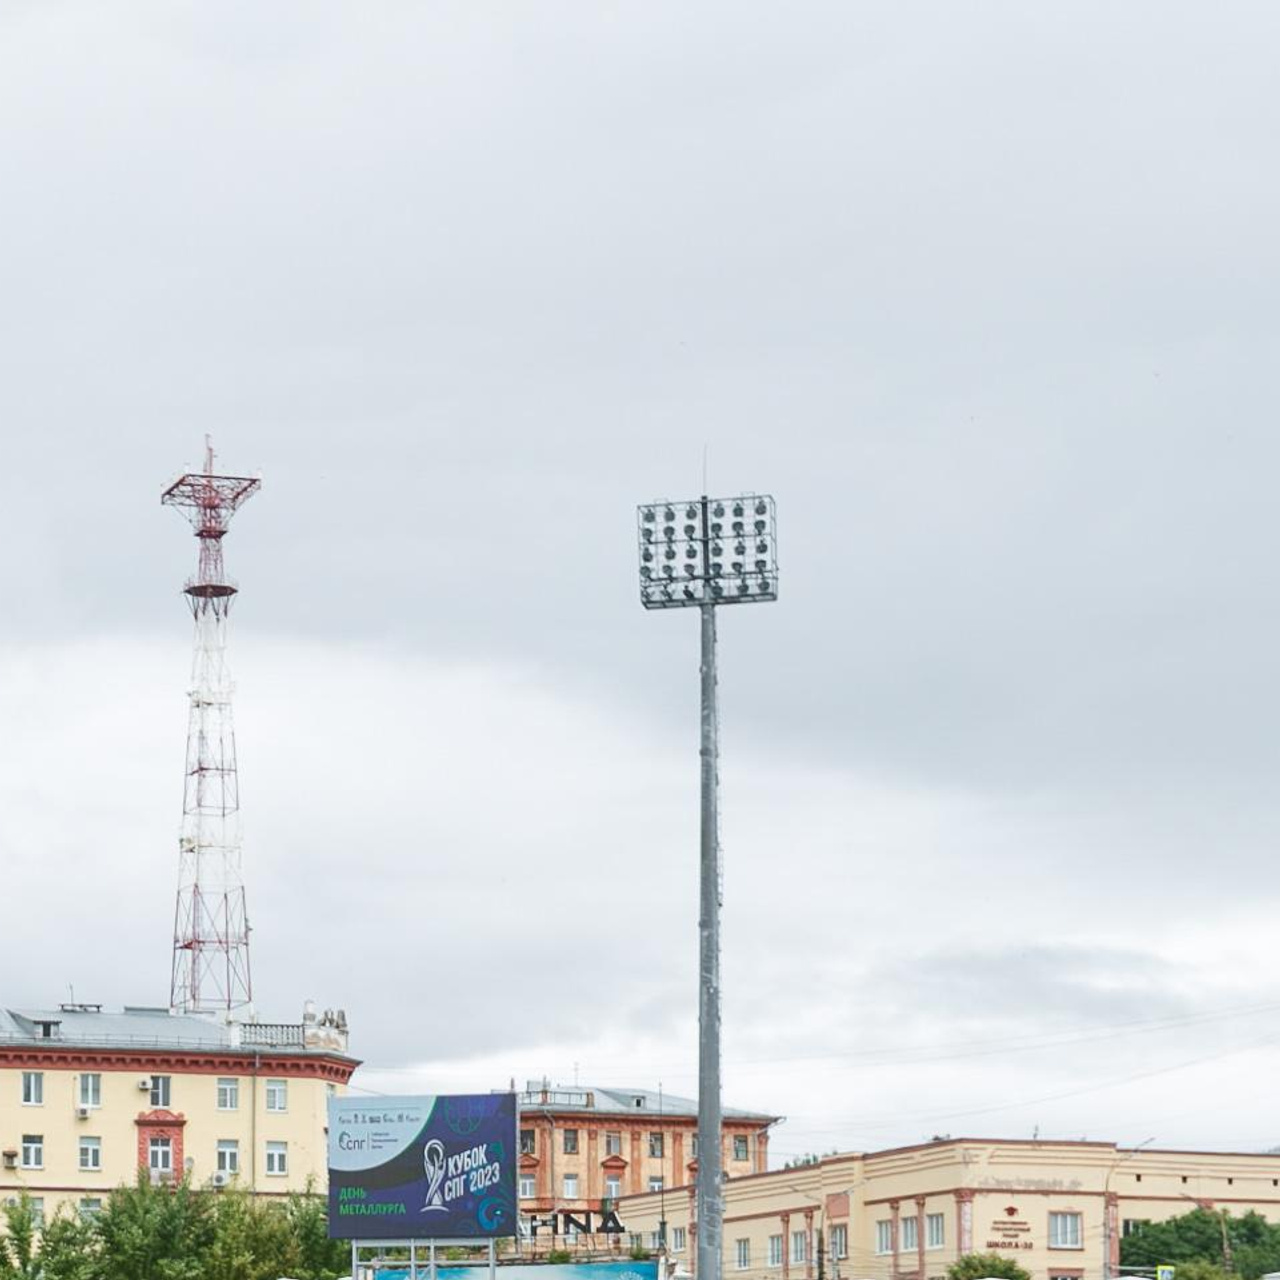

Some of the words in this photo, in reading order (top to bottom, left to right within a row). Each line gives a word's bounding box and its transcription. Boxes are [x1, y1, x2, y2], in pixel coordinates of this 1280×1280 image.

[447, 1143, 488, 1177] КУБОК
[444, 1175, 467, 1201] СПГ
[469, 1162, 500, 1192] 2023
[339, 1187, 366, 1201] ДЕНЬ
[339, 1202, 407, 1216] МЕТАЛЛУРГА
